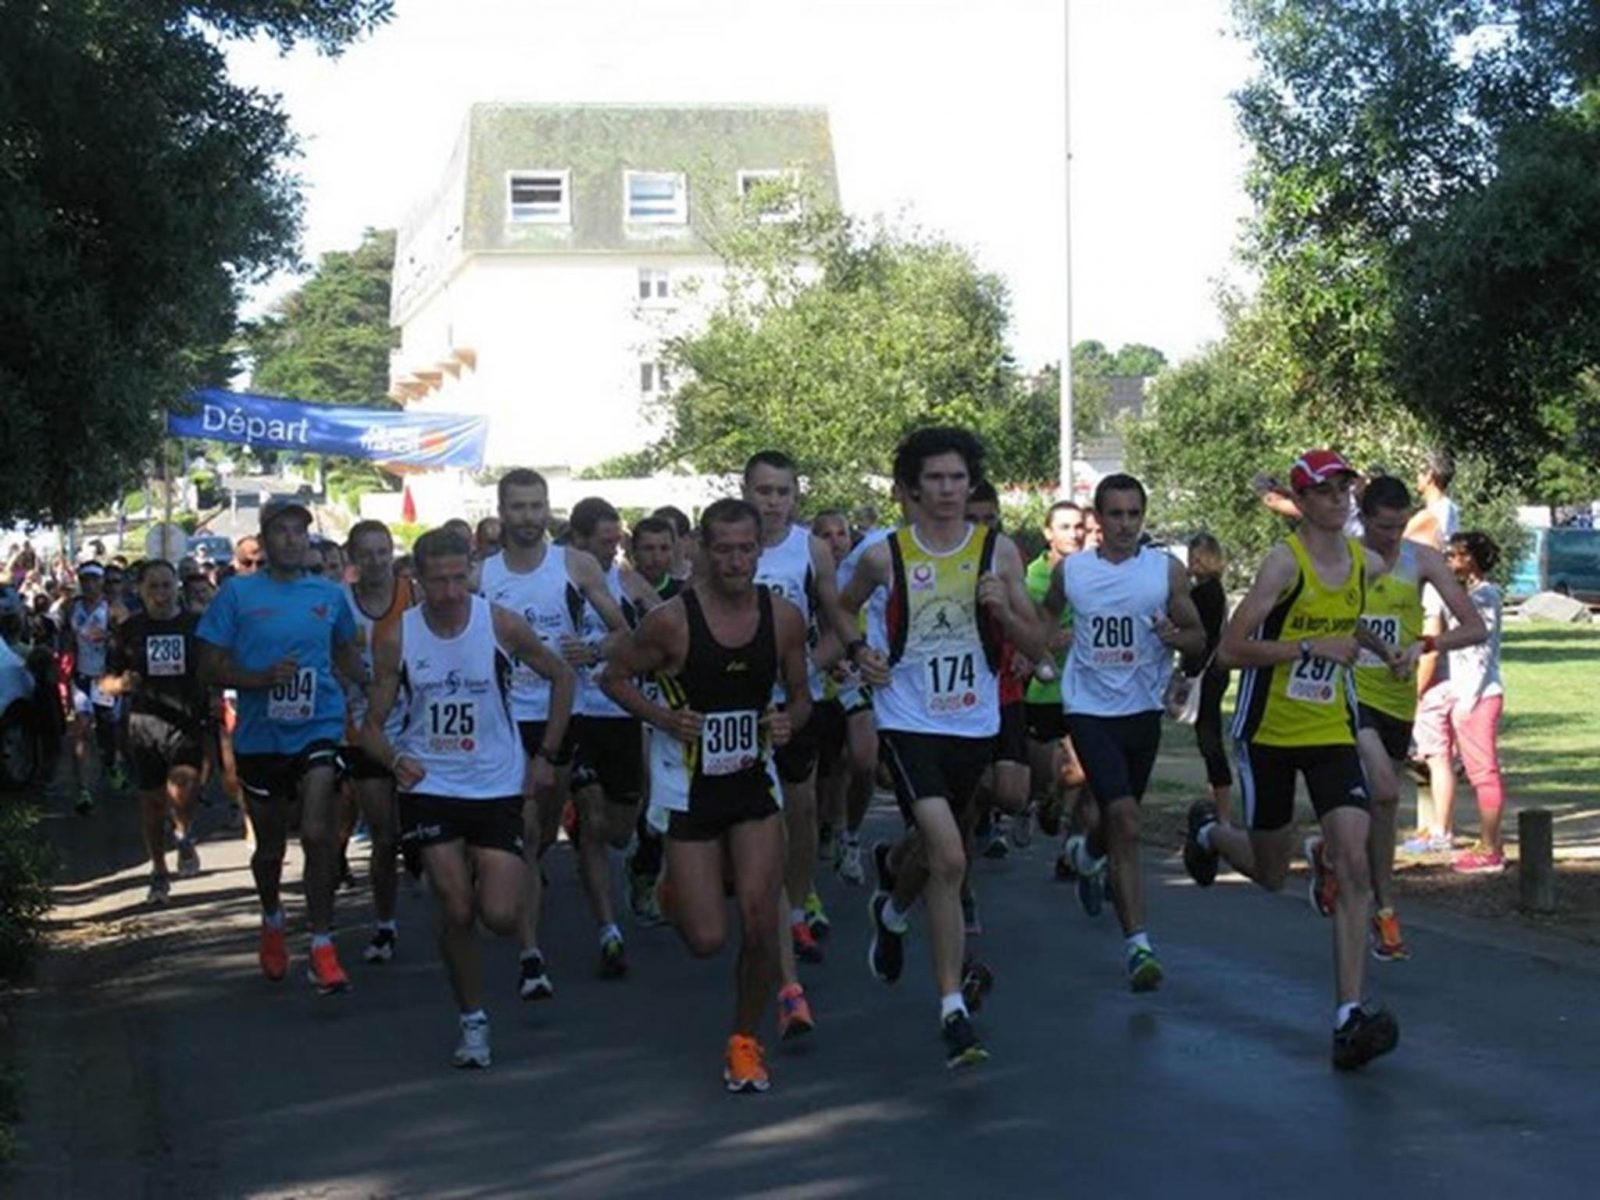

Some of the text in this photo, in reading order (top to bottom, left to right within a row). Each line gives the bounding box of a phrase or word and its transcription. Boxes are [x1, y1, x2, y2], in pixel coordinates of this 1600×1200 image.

[202, 404, 309, 444] Départ
[149, 637, 182, 662] 238
[1092, 615, 1134, 648] 260
[928, 653, 976, 694] 174
[429, 702, 475, 735] 125
[707, 714, 754, 754] 309
